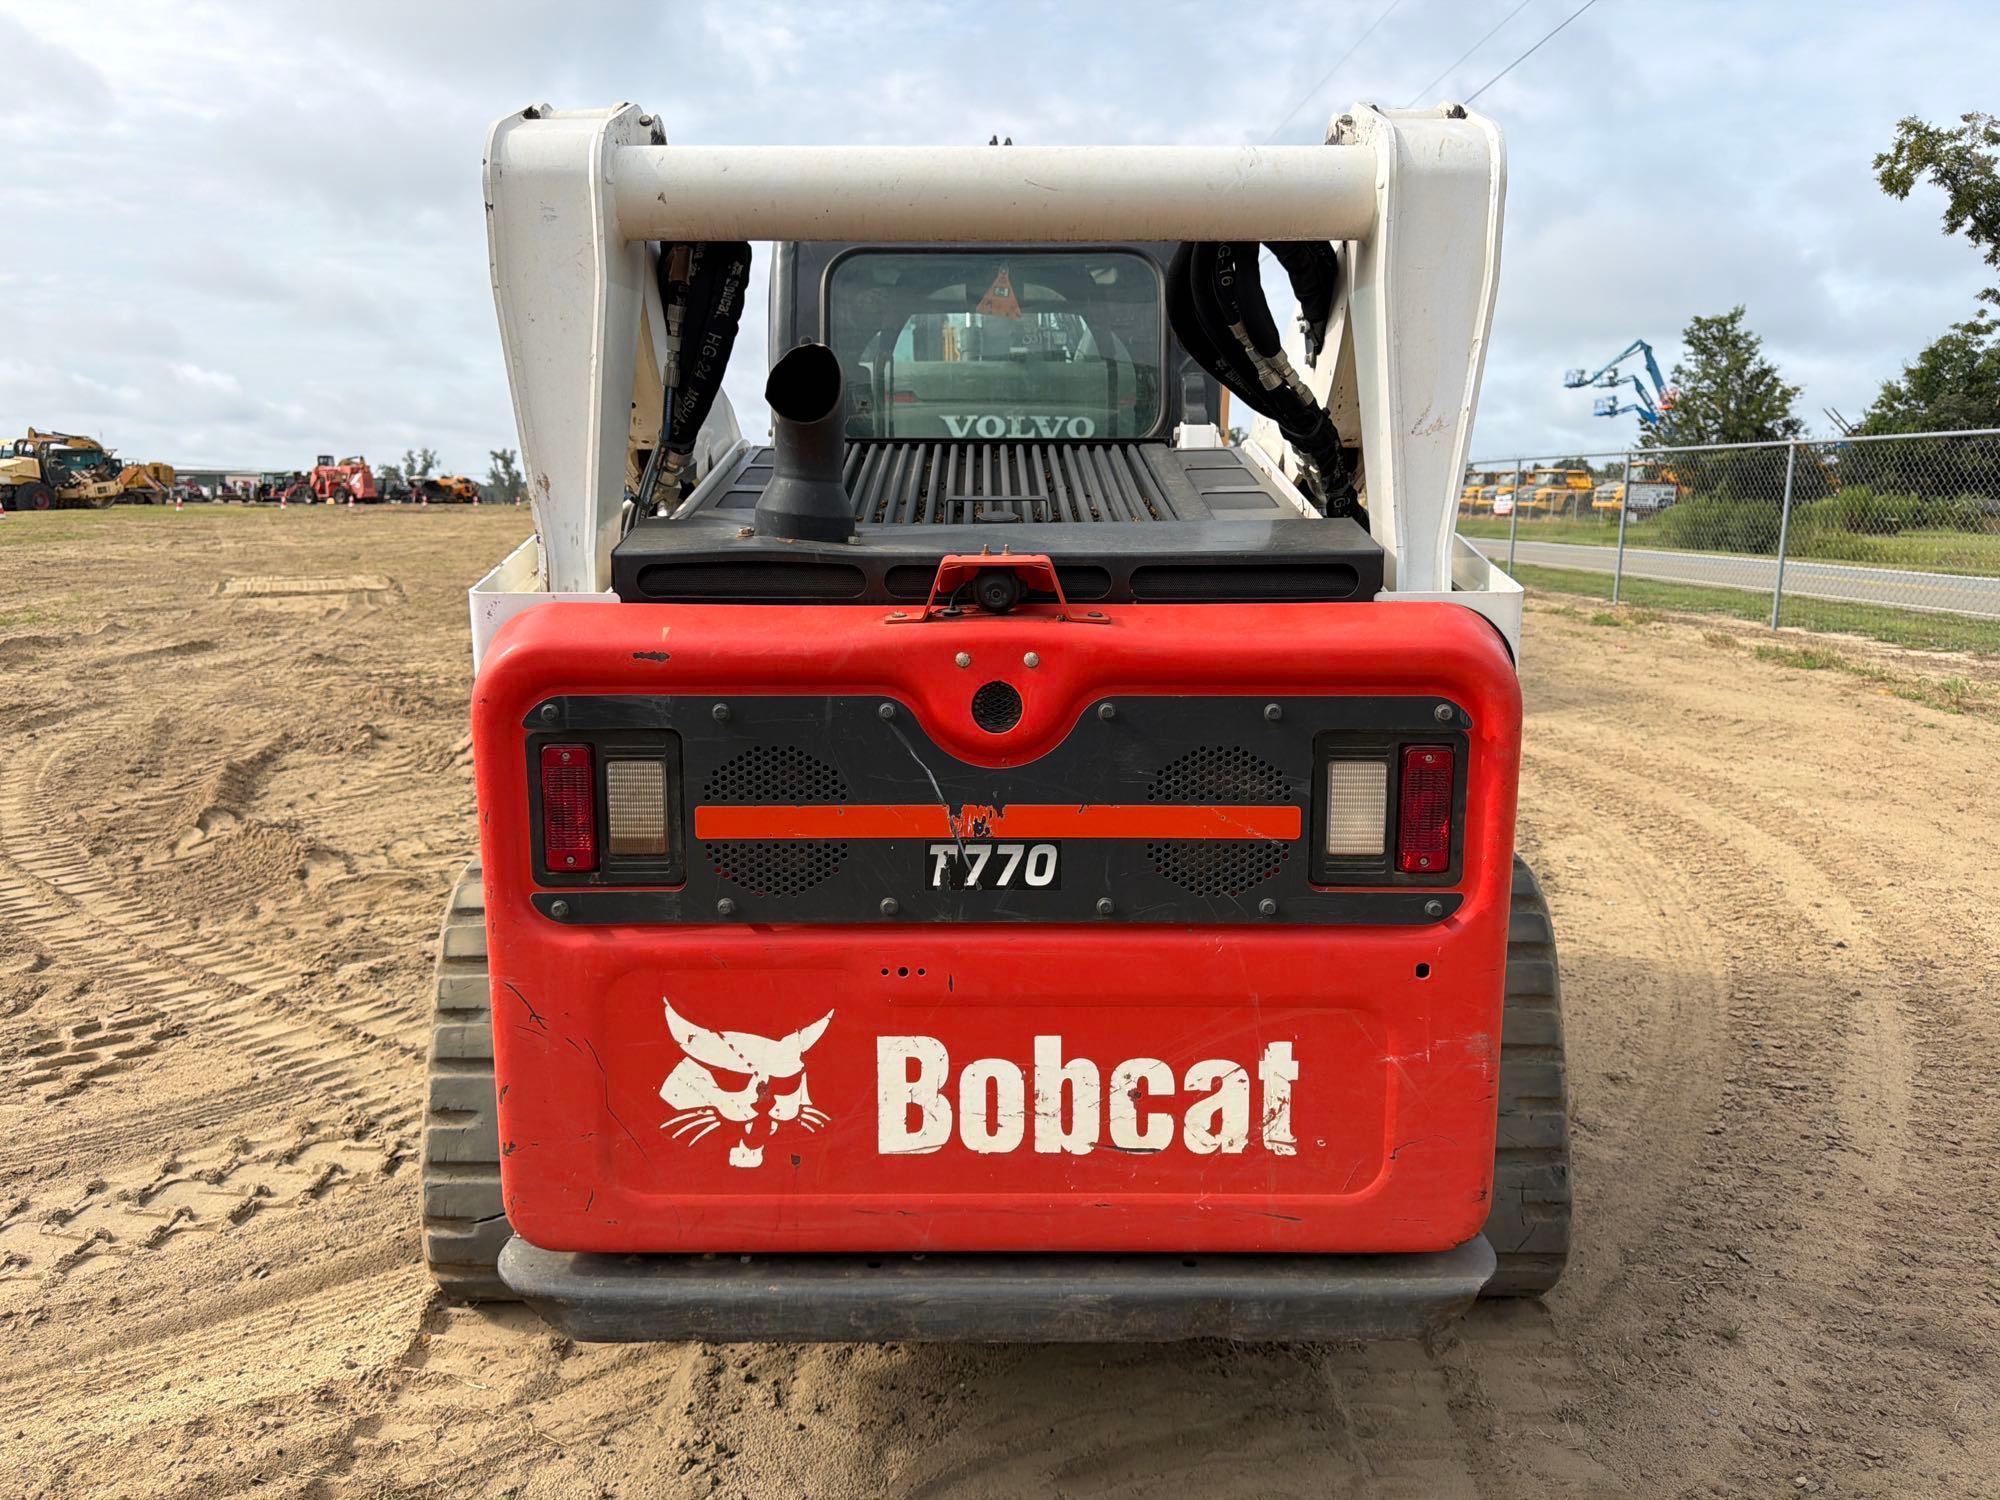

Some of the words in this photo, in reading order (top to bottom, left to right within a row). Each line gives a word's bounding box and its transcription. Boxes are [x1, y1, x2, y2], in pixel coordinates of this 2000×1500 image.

[939, 415, 1096, 438] VOLVO
[929, 843, 1058, 887] T770
[876, 1035, 1299, 1156] Bobcat
